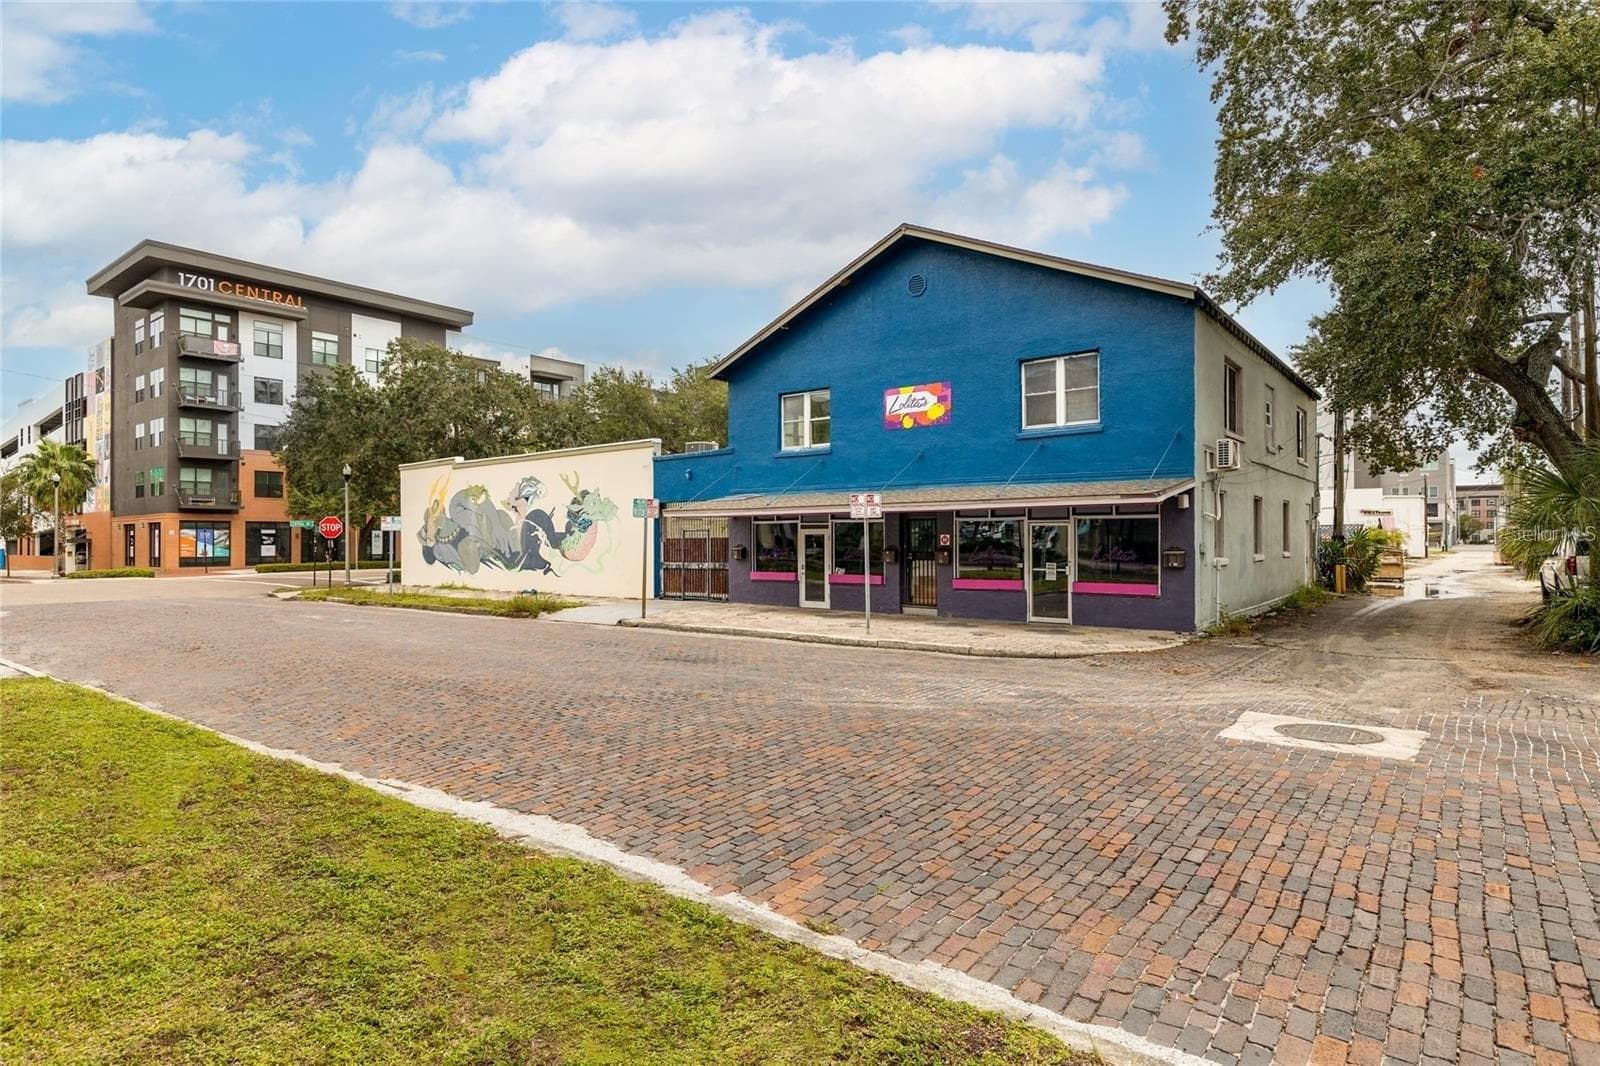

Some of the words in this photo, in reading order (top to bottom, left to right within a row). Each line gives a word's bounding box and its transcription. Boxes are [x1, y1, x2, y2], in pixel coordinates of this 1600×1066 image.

[178, 272, 214, 292] 1701
[218, 281, 306, 310] CENTRAL
[321, 523, 341, 532] STOP
